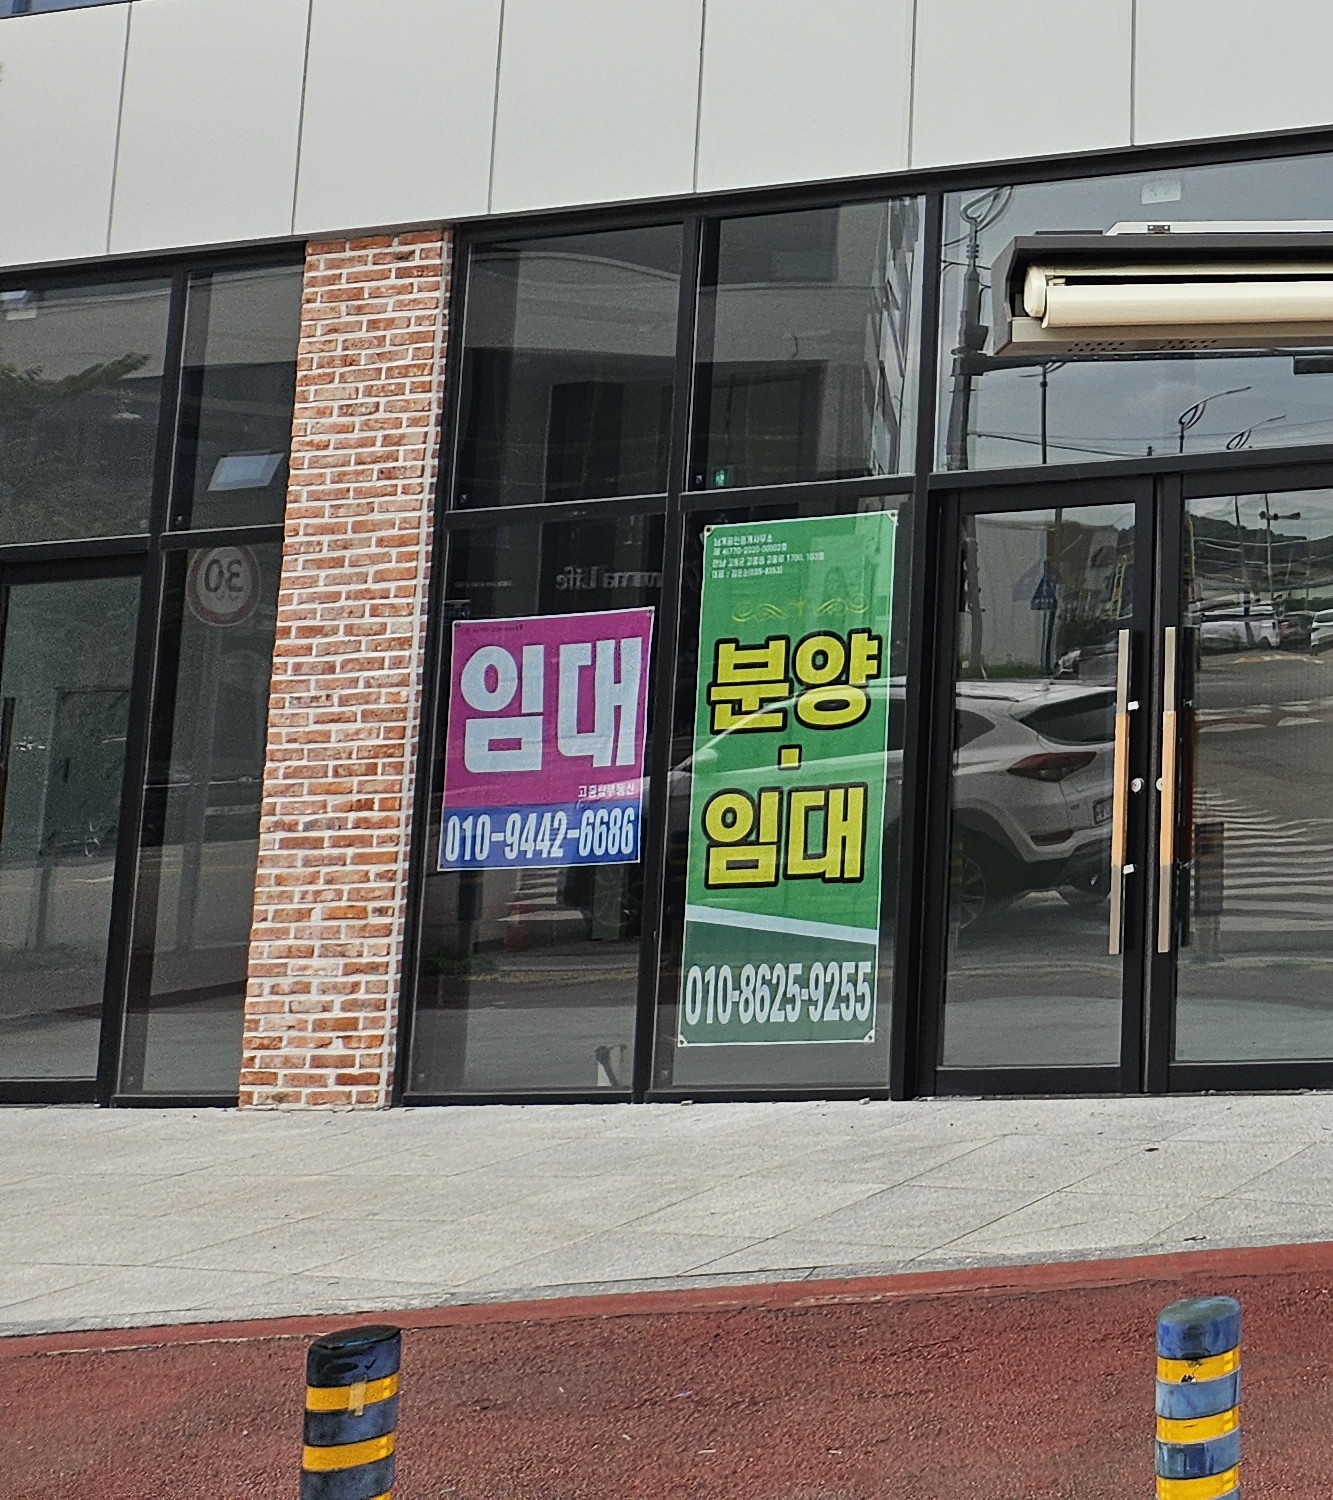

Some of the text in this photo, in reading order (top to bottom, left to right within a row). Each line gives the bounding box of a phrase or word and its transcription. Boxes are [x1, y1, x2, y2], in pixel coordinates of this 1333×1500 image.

[460, 636, 643, 774] 임대
[707, 630, 881, 733] 분양
[444, 806, 636, 861] 010-9442-6686
[704, 783, 868, 888] 임대
[684, 961, 873, 1025] 010-8625-9255
